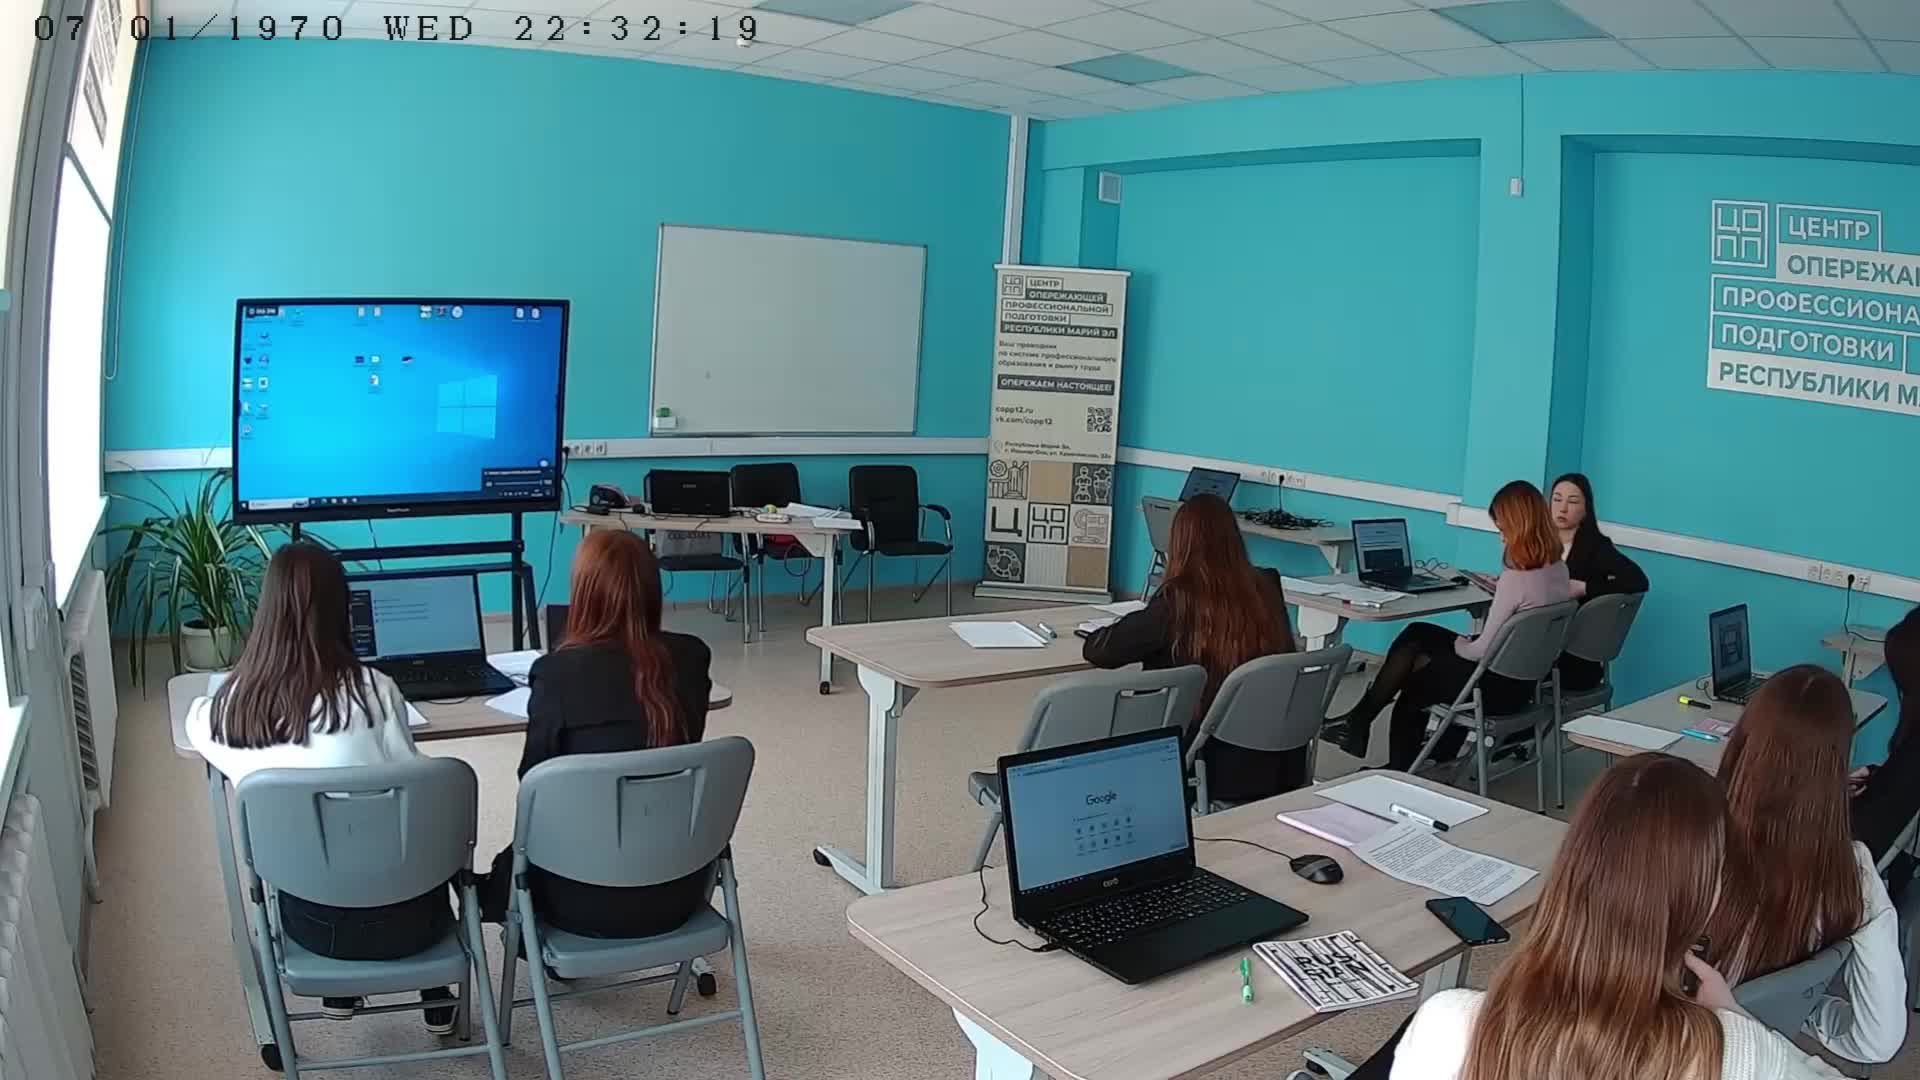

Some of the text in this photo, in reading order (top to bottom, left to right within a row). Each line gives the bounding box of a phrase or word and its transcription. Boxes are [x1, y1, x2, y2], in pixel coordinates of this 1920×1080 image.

[1789, 216, 1870, 240] ЦЕНТР
[1788, 255, 1920, 288] ОПЕРЕЖА
[1030, 279, 1060, 288] ЦЕНТР
[1029, 292, 1104, 302] ОПЕРЕЖАЮЩЕЙ
[1006, 301, 1108, 313] ПРОФЕССИОНАЛЬНОЙ
[1005, 313, 1066, 322] ПОДГОТОВКИ
[1005, 324, 1065, 335] РЕСПУБЛИКИ
[1068, 327, 1099, 336] МАРИЙ
[1721, 324, 1894, 362] ПОДГОТОВКИ
[1001, 378, 1054, 388] ОПЕРЕЖАЕМ
[1720, 362, 1889, 402] РЕСПУБЛИКИ
[996, 406, 1034, 414] copp12.ru
[996, 416, 1052, 425] vk.com/copp12
[991, 506, 1022, 537] Ц
[1085, 789, 1118, 805] Google
